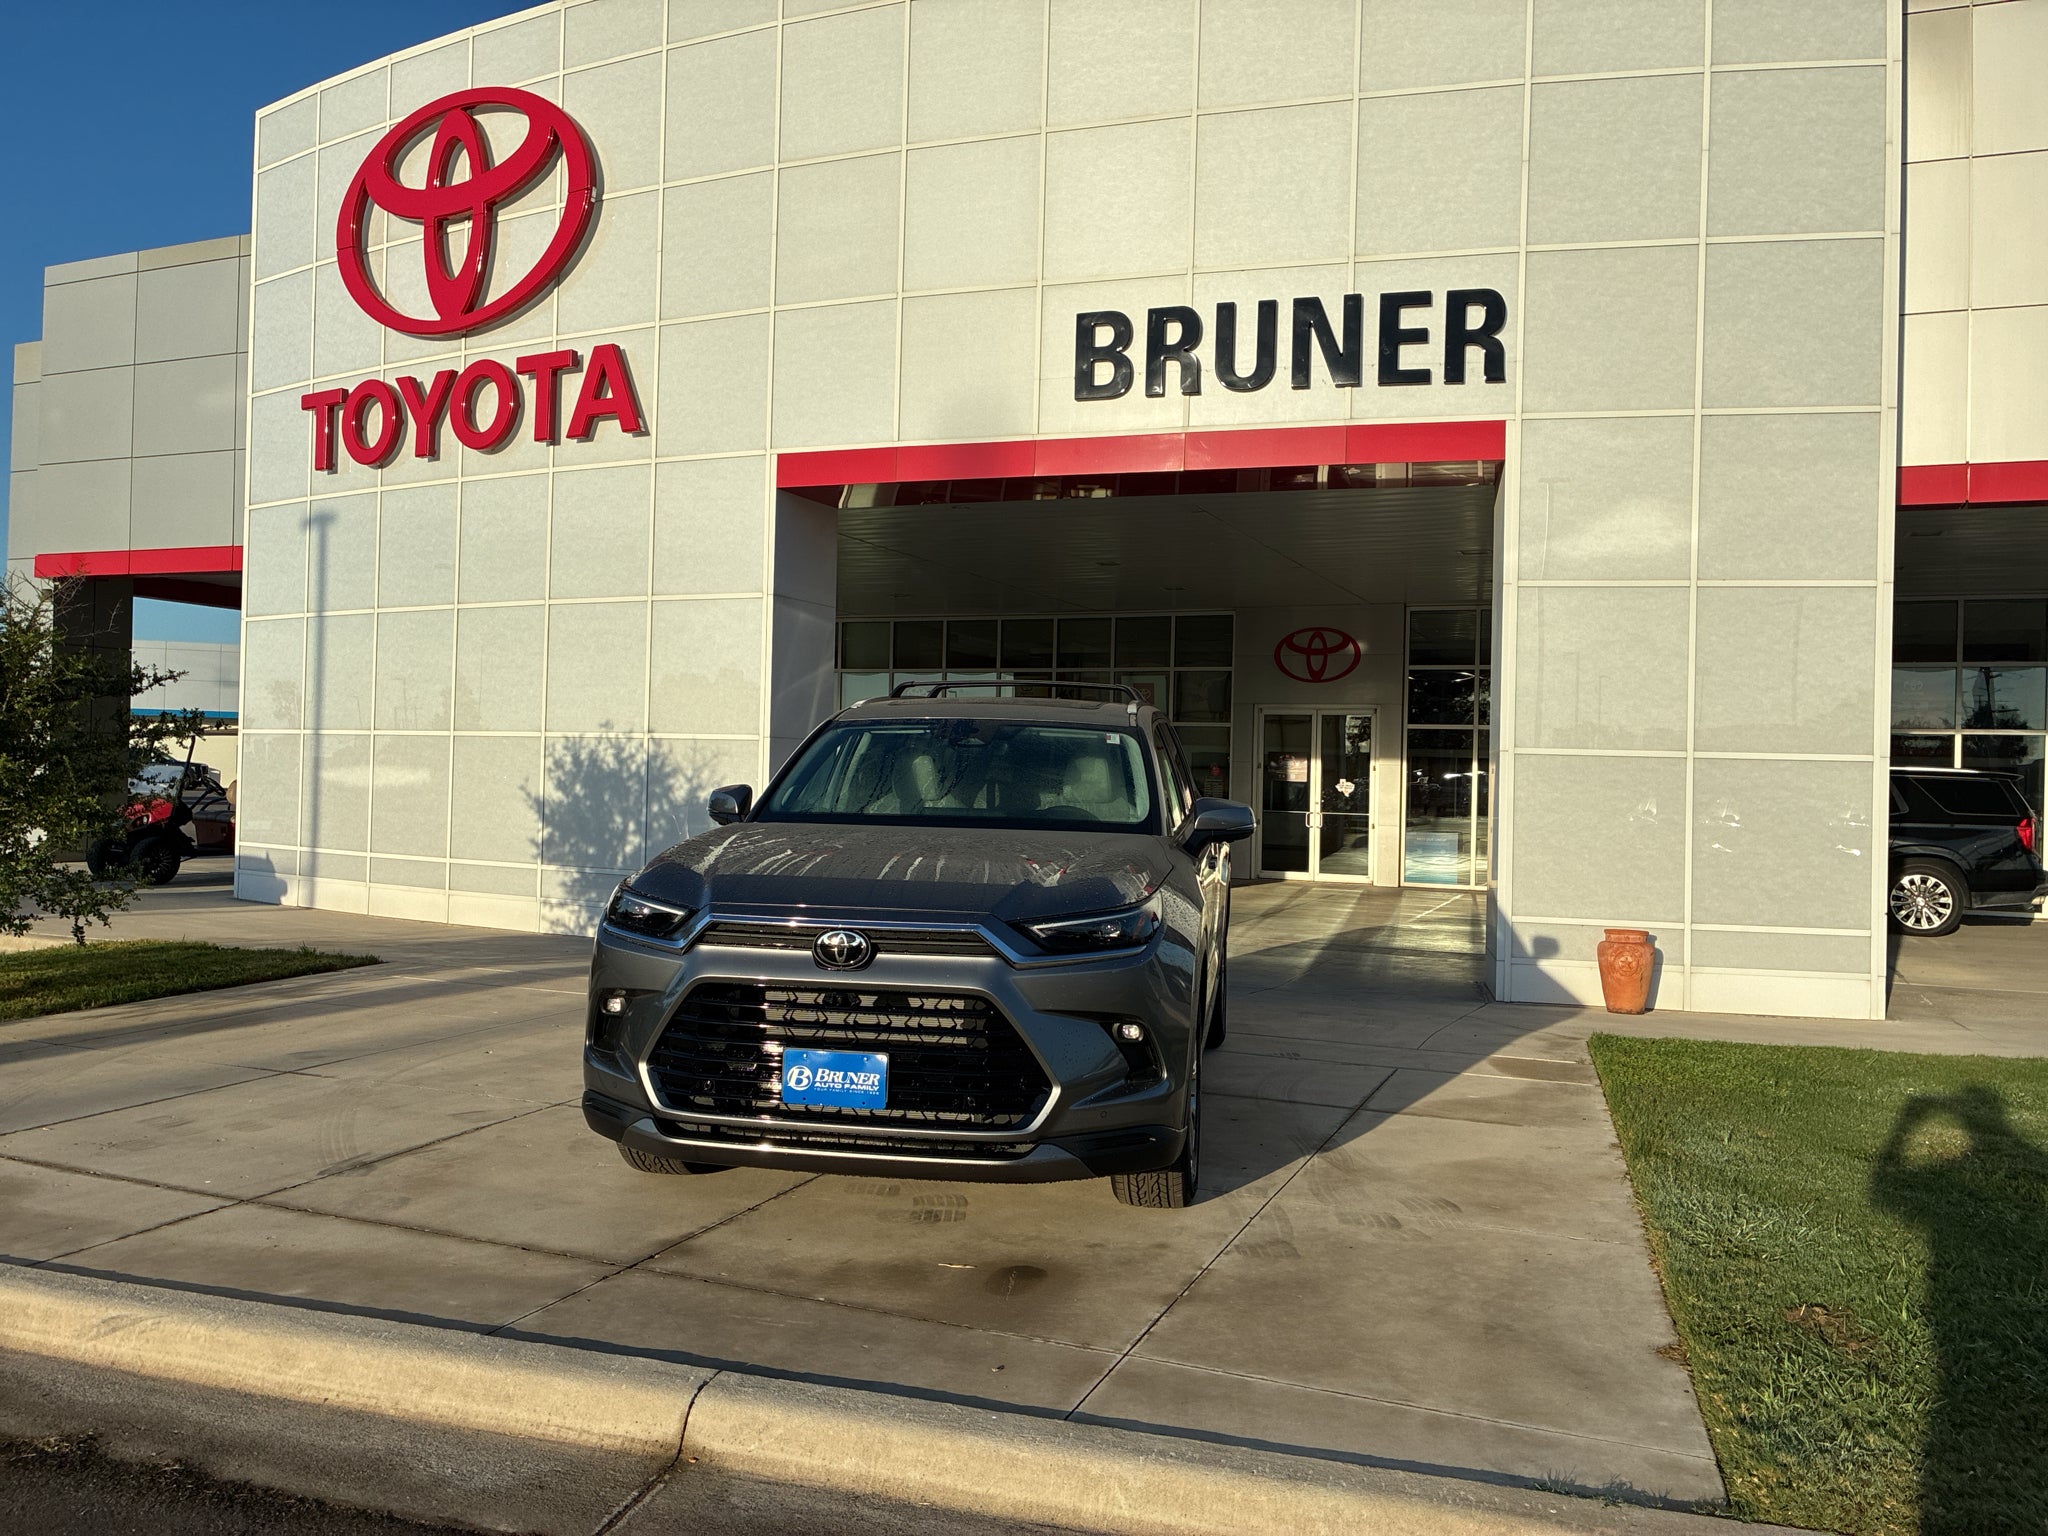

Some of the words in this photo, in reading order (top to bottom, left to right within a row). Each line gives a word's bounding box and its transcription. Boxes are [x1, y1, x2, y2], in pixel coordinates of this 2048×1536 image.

[1074, 288, 1508, 401] BRUNER
[301, 343, 643, 472] TOYOTA
[814, 1068, 880, 1086] BRUNER
[814, 1081, 843, 1089] AUTO
[844, 1083, 880, 1091] FAMILY
